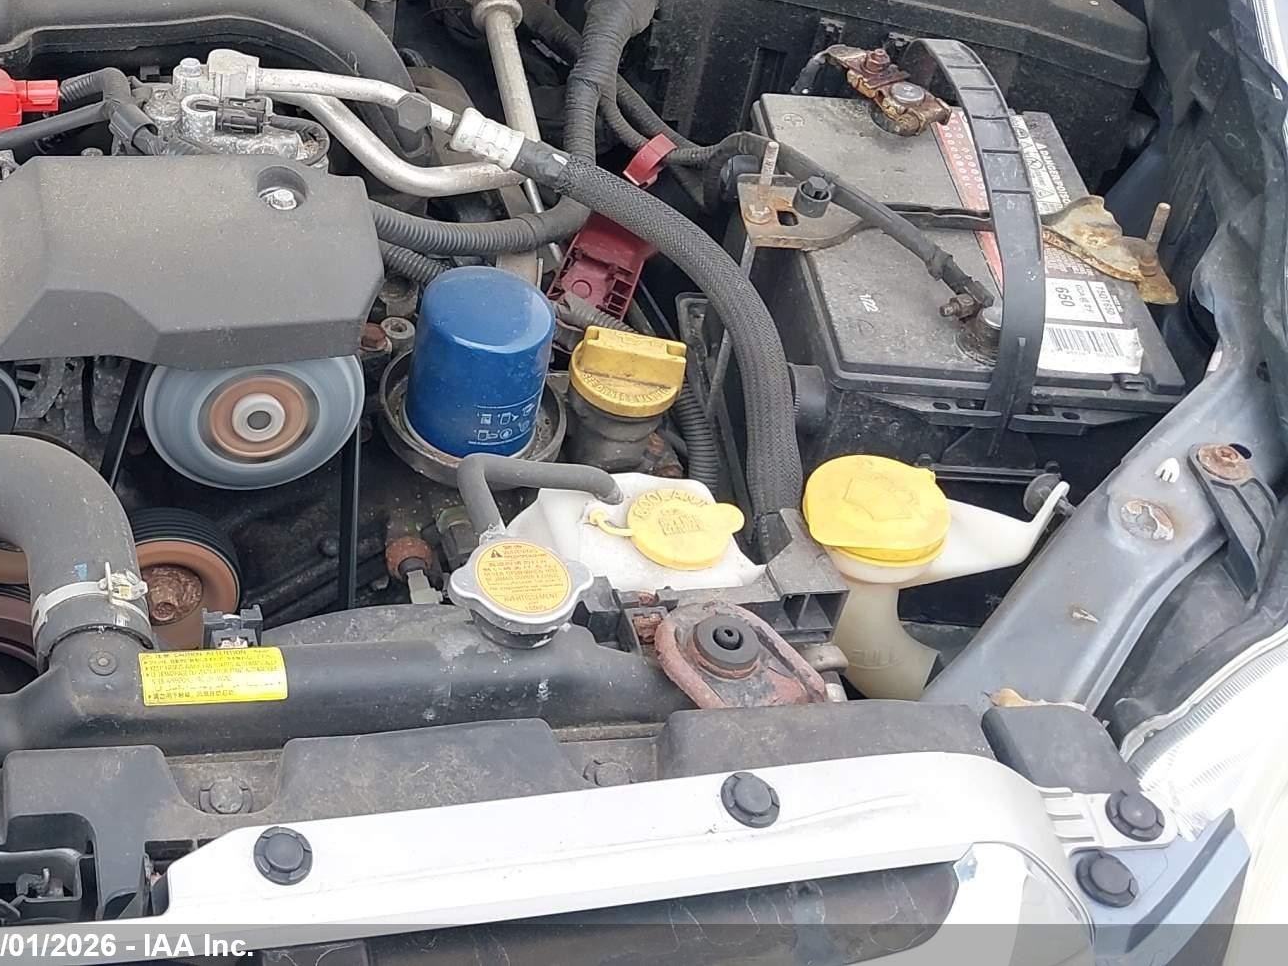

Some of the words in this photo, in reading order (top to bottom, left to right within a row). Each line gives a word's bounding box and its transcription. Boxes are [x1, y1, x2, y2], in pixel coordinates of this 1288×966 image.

[1053, 180, 1073, 206] POISO
[858, 293, 879, 313] 1/22
[1055, 287, 1076, 307] 650
[633, 489, 710, 520] COOLANT
